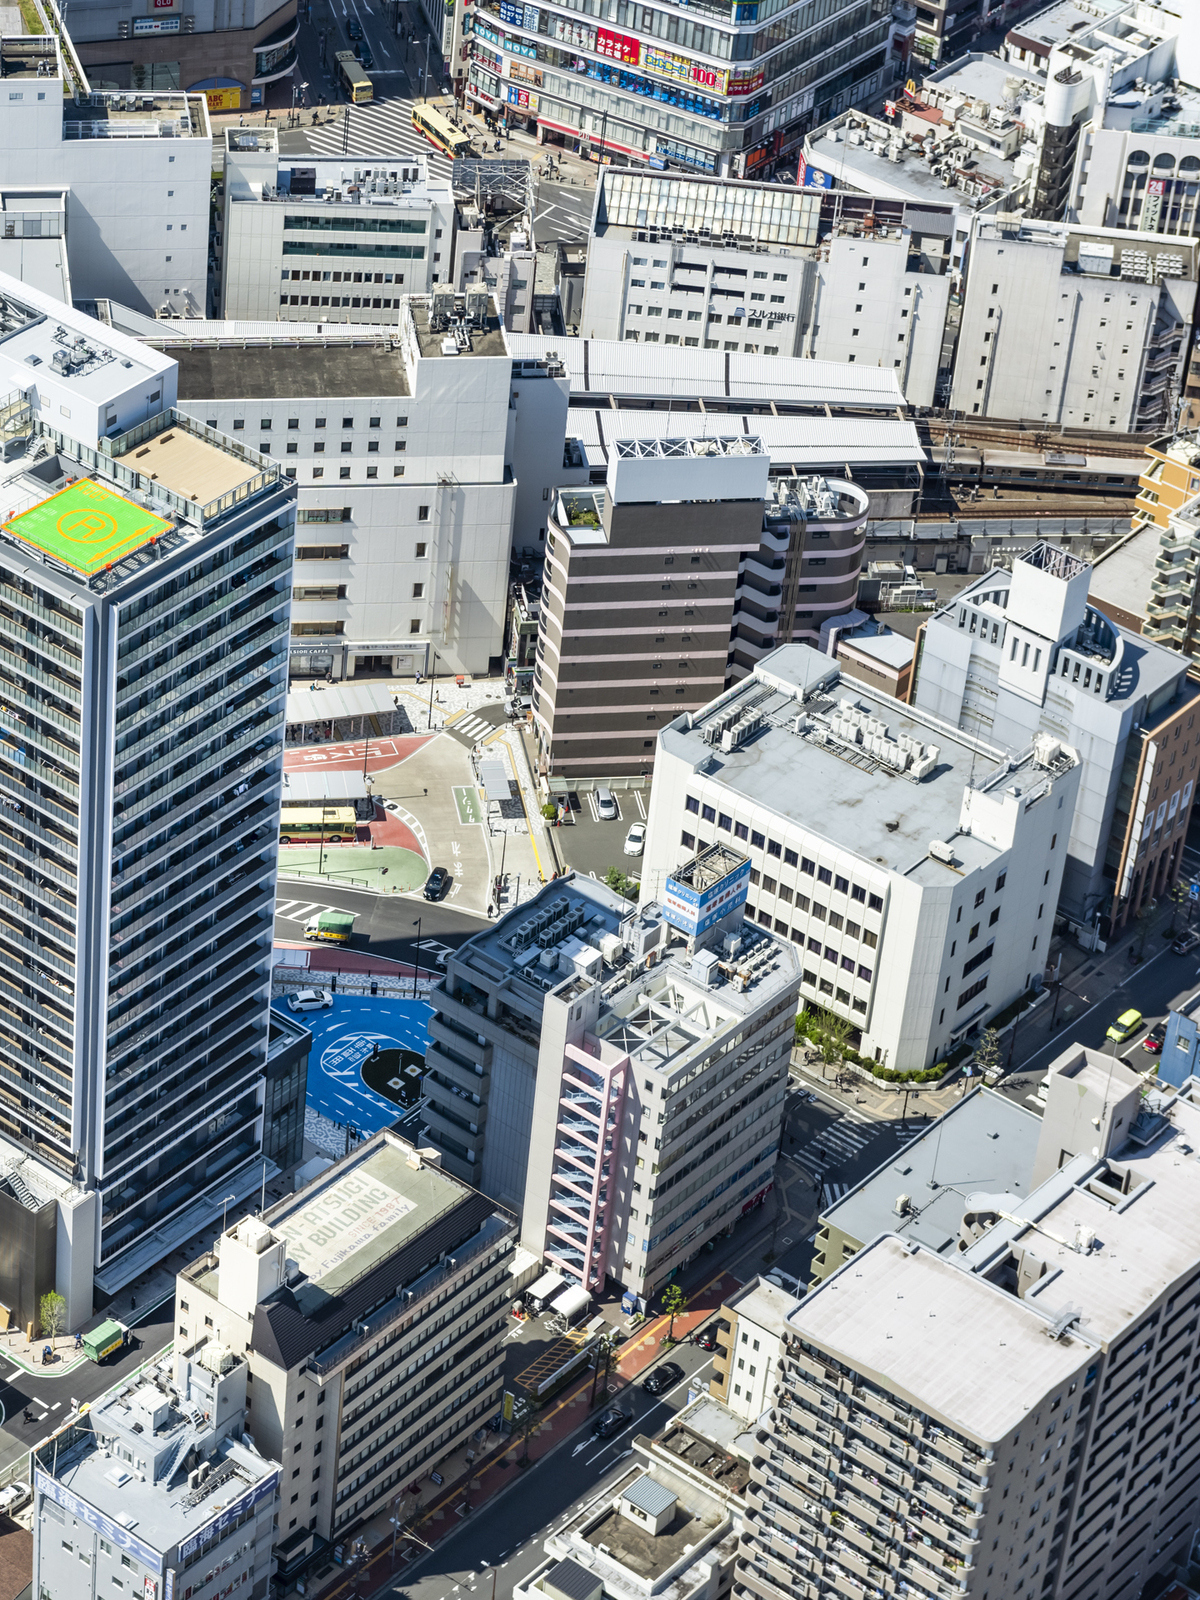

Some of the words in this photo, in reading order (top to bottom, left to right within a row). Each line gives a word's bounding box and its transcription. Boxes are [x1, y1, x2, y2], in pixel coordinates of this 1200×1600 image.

[475, 23, 496, 42] NOVA
[506, 42, 535, 58] NOVA
[598, 38, 630, 52] カラオケ
[623, 55, 636, 63] 5F
[646, 55, 686, 75] ネットルーム
[208, 94, 223, 102] ABC
[480, 93, 494, 104] KFC
[1149, 181, 1163, 191] 24
[1147, 195, 1159, 231] フィットネ
[748, 308, 795, 322] スルガ銀行
[67, 514, 106, 539] R
[462, 788, 475, 823] タクシー
[451, 841, 463, 898] 止まれ
[308, 1188, 389, 1247] BUILDING
[348, 1217, 376, 1238] SINCE
[374, 1197, 400, 1217] 1987
[321, 1232, 373, 1268] Fujikawa
[372, 1204, 410, 1232] family
[38, 1474, 158, 1565] 臨海セミナー
[183, 1480, 275, 1558] 臨海セミナー
